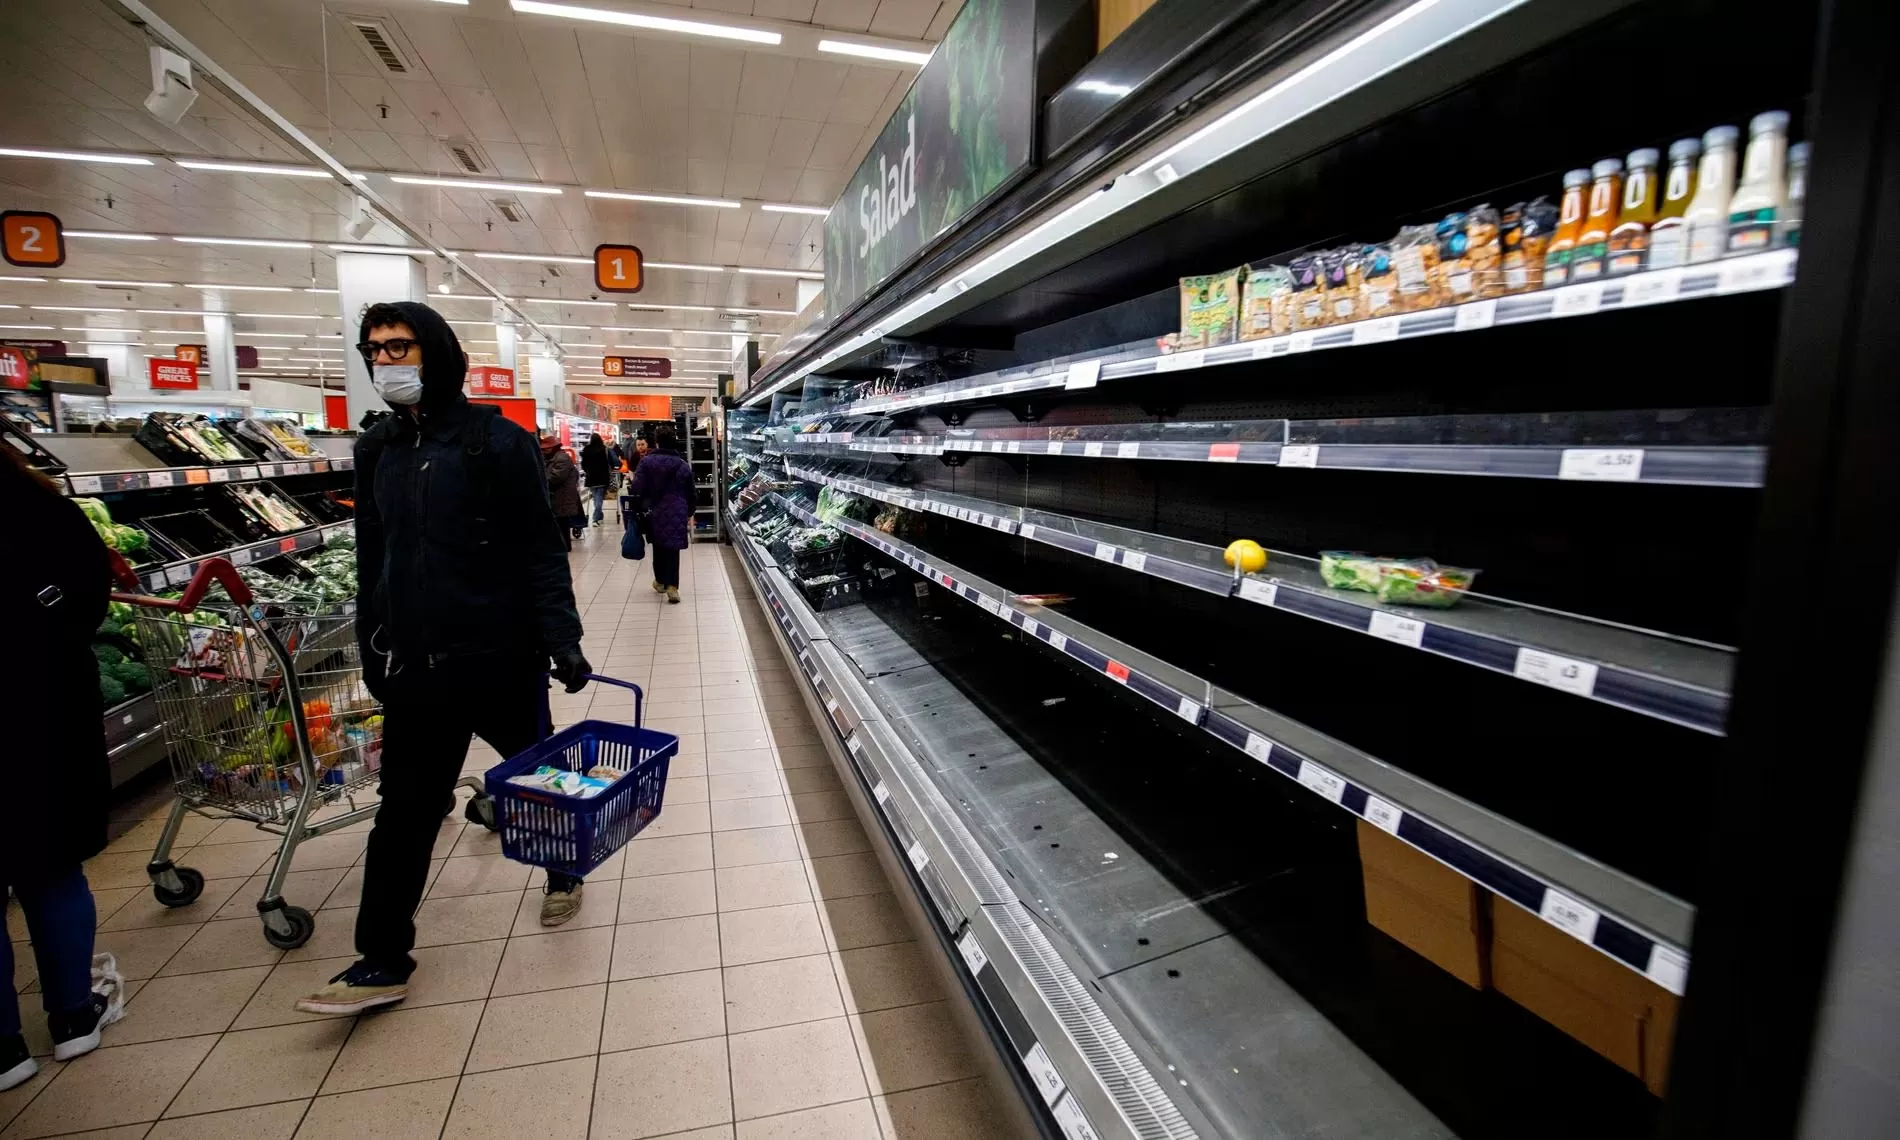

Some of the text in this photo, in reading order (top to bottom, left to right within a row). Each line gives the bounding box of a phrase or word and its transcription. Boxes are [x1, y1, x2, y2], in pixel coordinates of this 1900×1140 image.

[860, 113, 917, 259] Salad
[20, 226, 43, 252] 2
[611, 257, 626, 280] 1
[157, 365, 190, 375] GREAT
[606, 361, 620, 372] 19
[157, 372, 193, 383] PRICES
[490, 373, 509, 382] GREAT
[489, 380, 511, 389] PRICES
